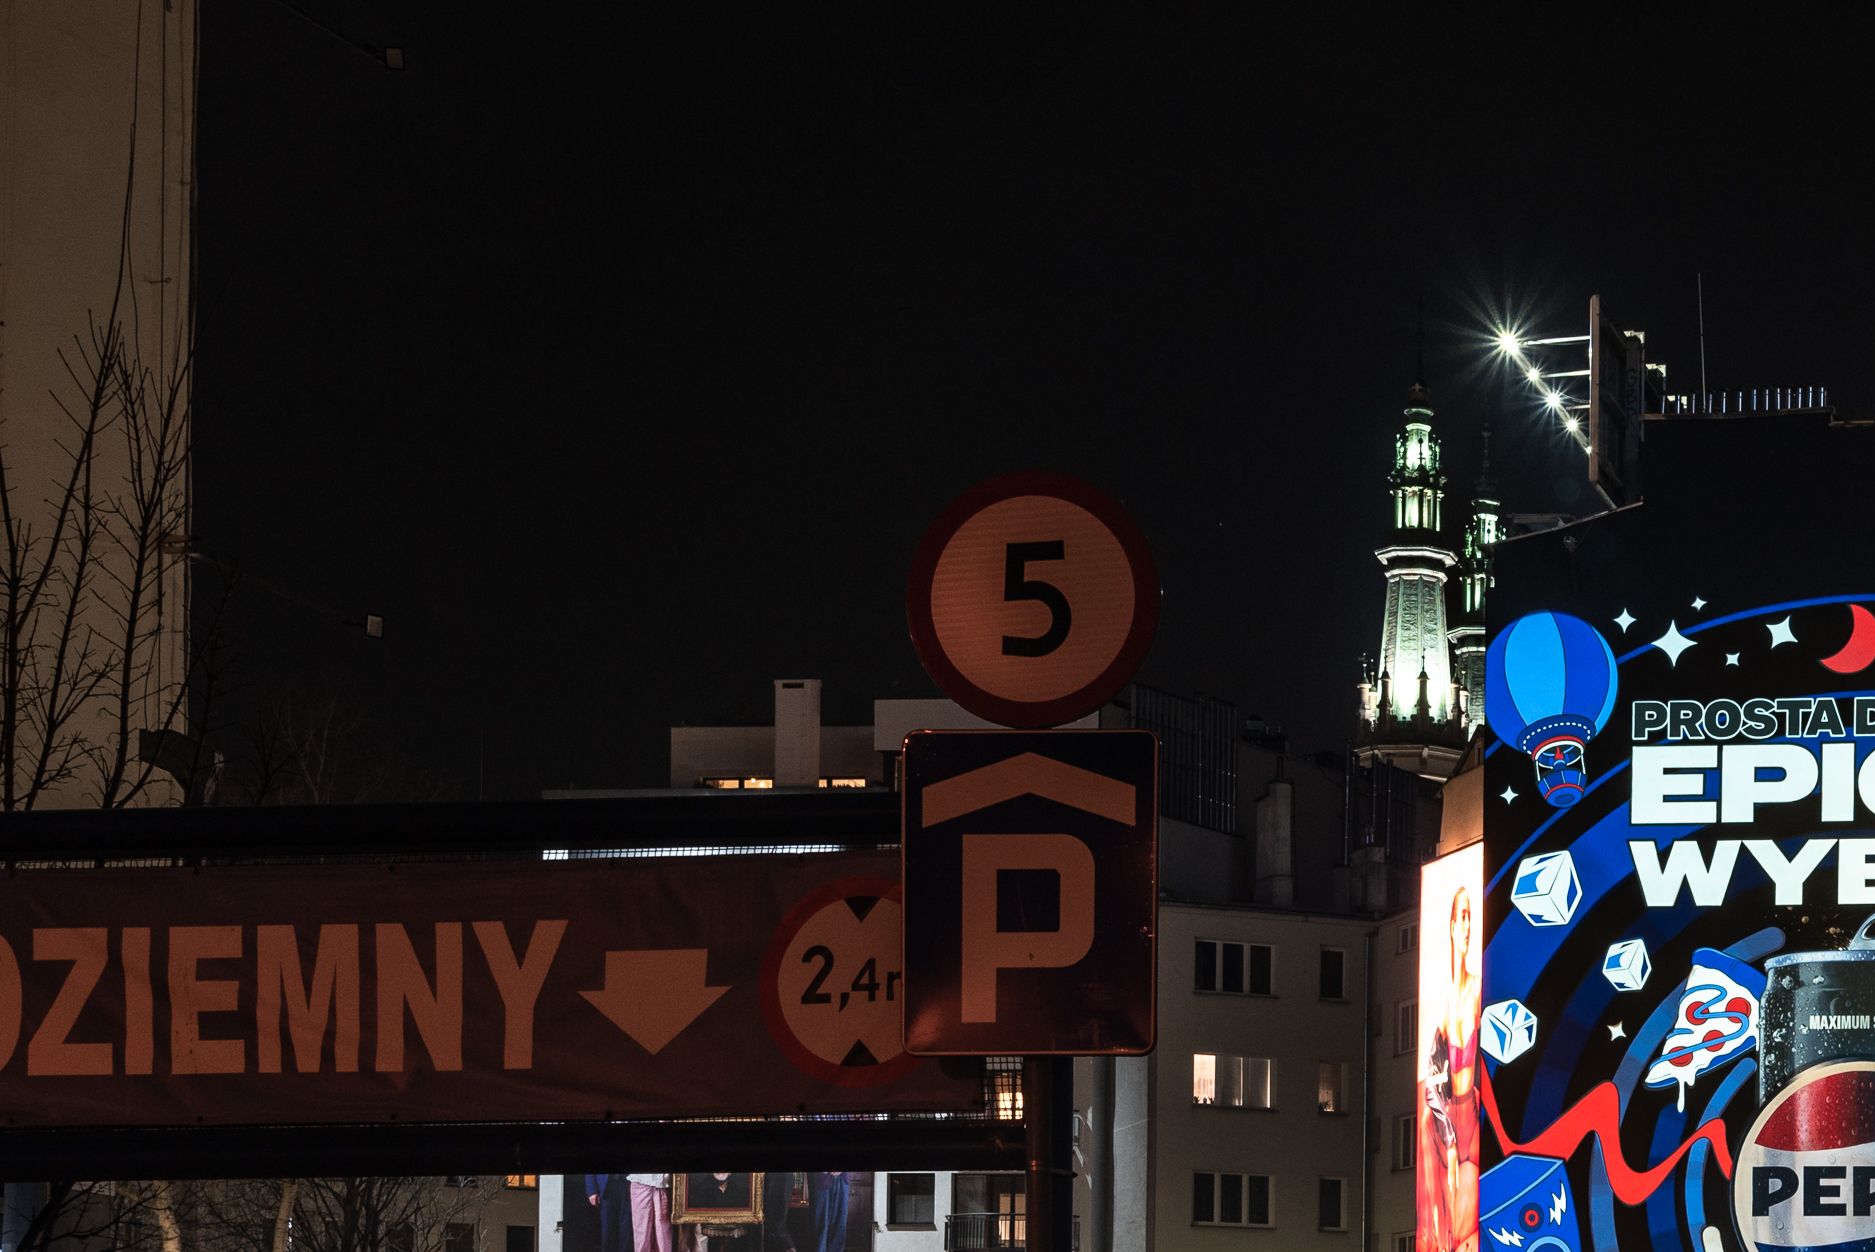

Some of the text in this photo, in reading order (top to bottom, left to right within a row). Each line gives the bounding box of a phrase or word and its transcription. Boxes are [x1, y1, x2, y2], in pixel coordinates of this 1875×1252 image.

[1000, 538, 1072, 658] 5
[1632, 698, 1846, 740] PROSTA
[961, 833, 1096, 1024] P
[1809, 1014, 1870, 1030] MAXIMUM
